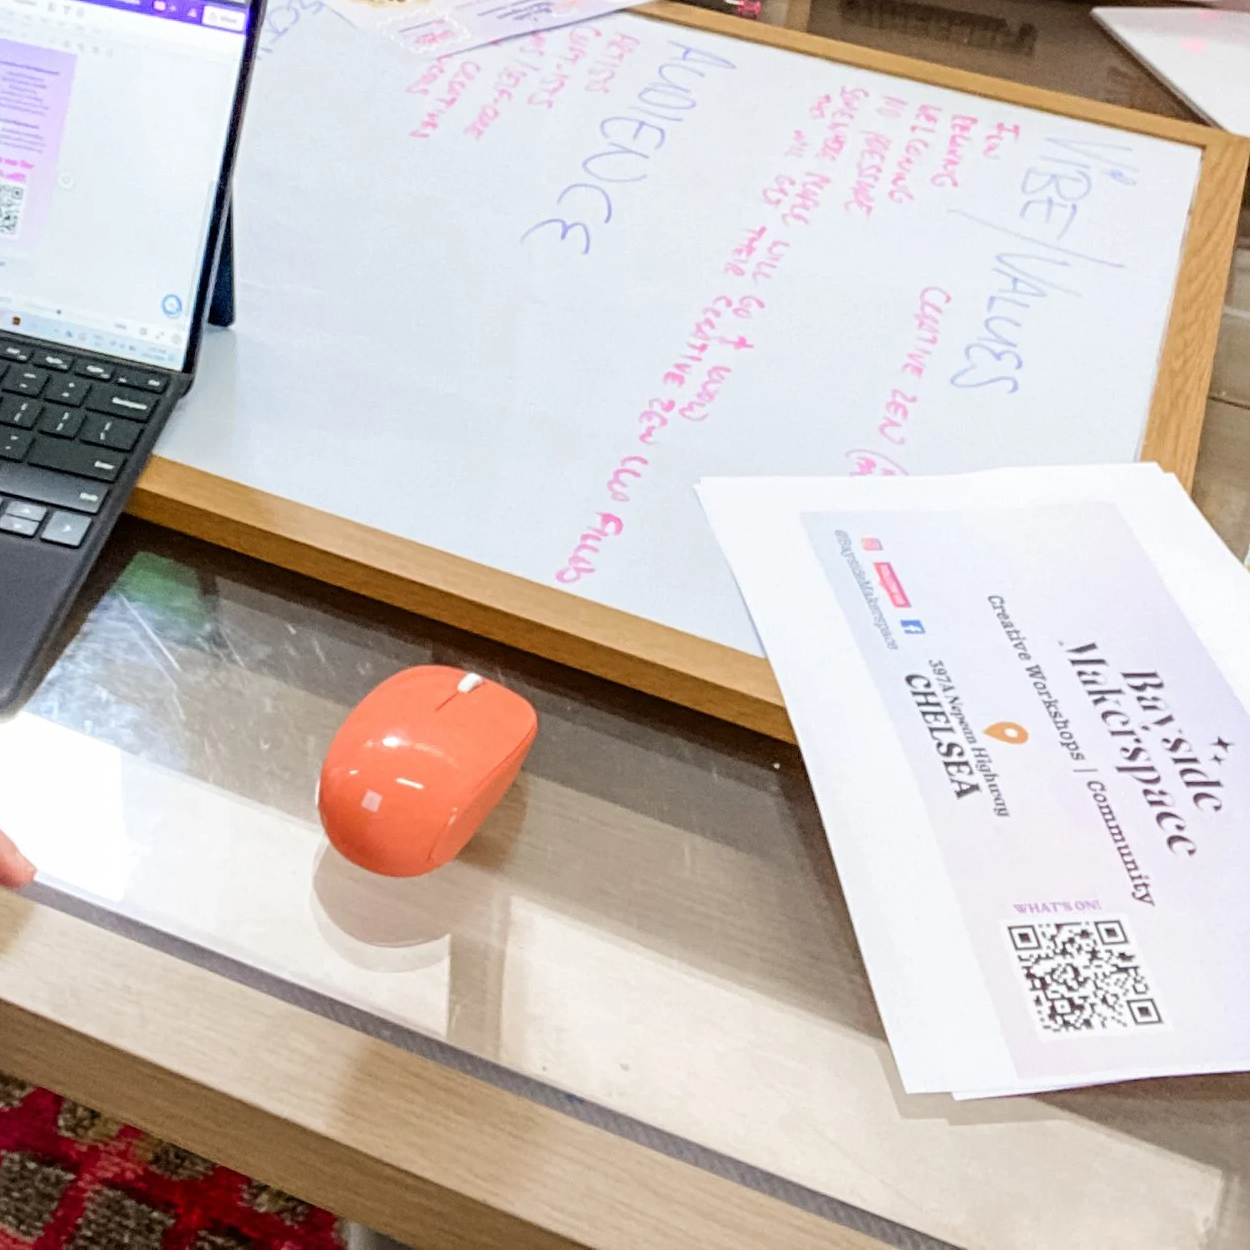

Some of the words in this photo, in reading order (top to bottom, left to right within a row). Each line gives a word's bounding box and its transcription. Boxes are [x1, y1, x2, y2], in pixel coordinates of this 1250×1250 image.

[519, 39, 737, 255] AUDIENCE
[904, 672, 983, 800] CHELSEA
[946, 691, 978, 745] Nepean
[971, 745, 1011, 818] Highway
[986, 594, 1033, 662] Creative
[1024, 663, 1087, 762] Workshops
[1085, 779, 1156, 907] Community
[1058, 641, 1198, 857] Makerspace
[1120, 669, 1225, 813] Bayside
[1014, 901, 1072, 917] WHAT'S
[1073, 900, 1103, 913] ON!
